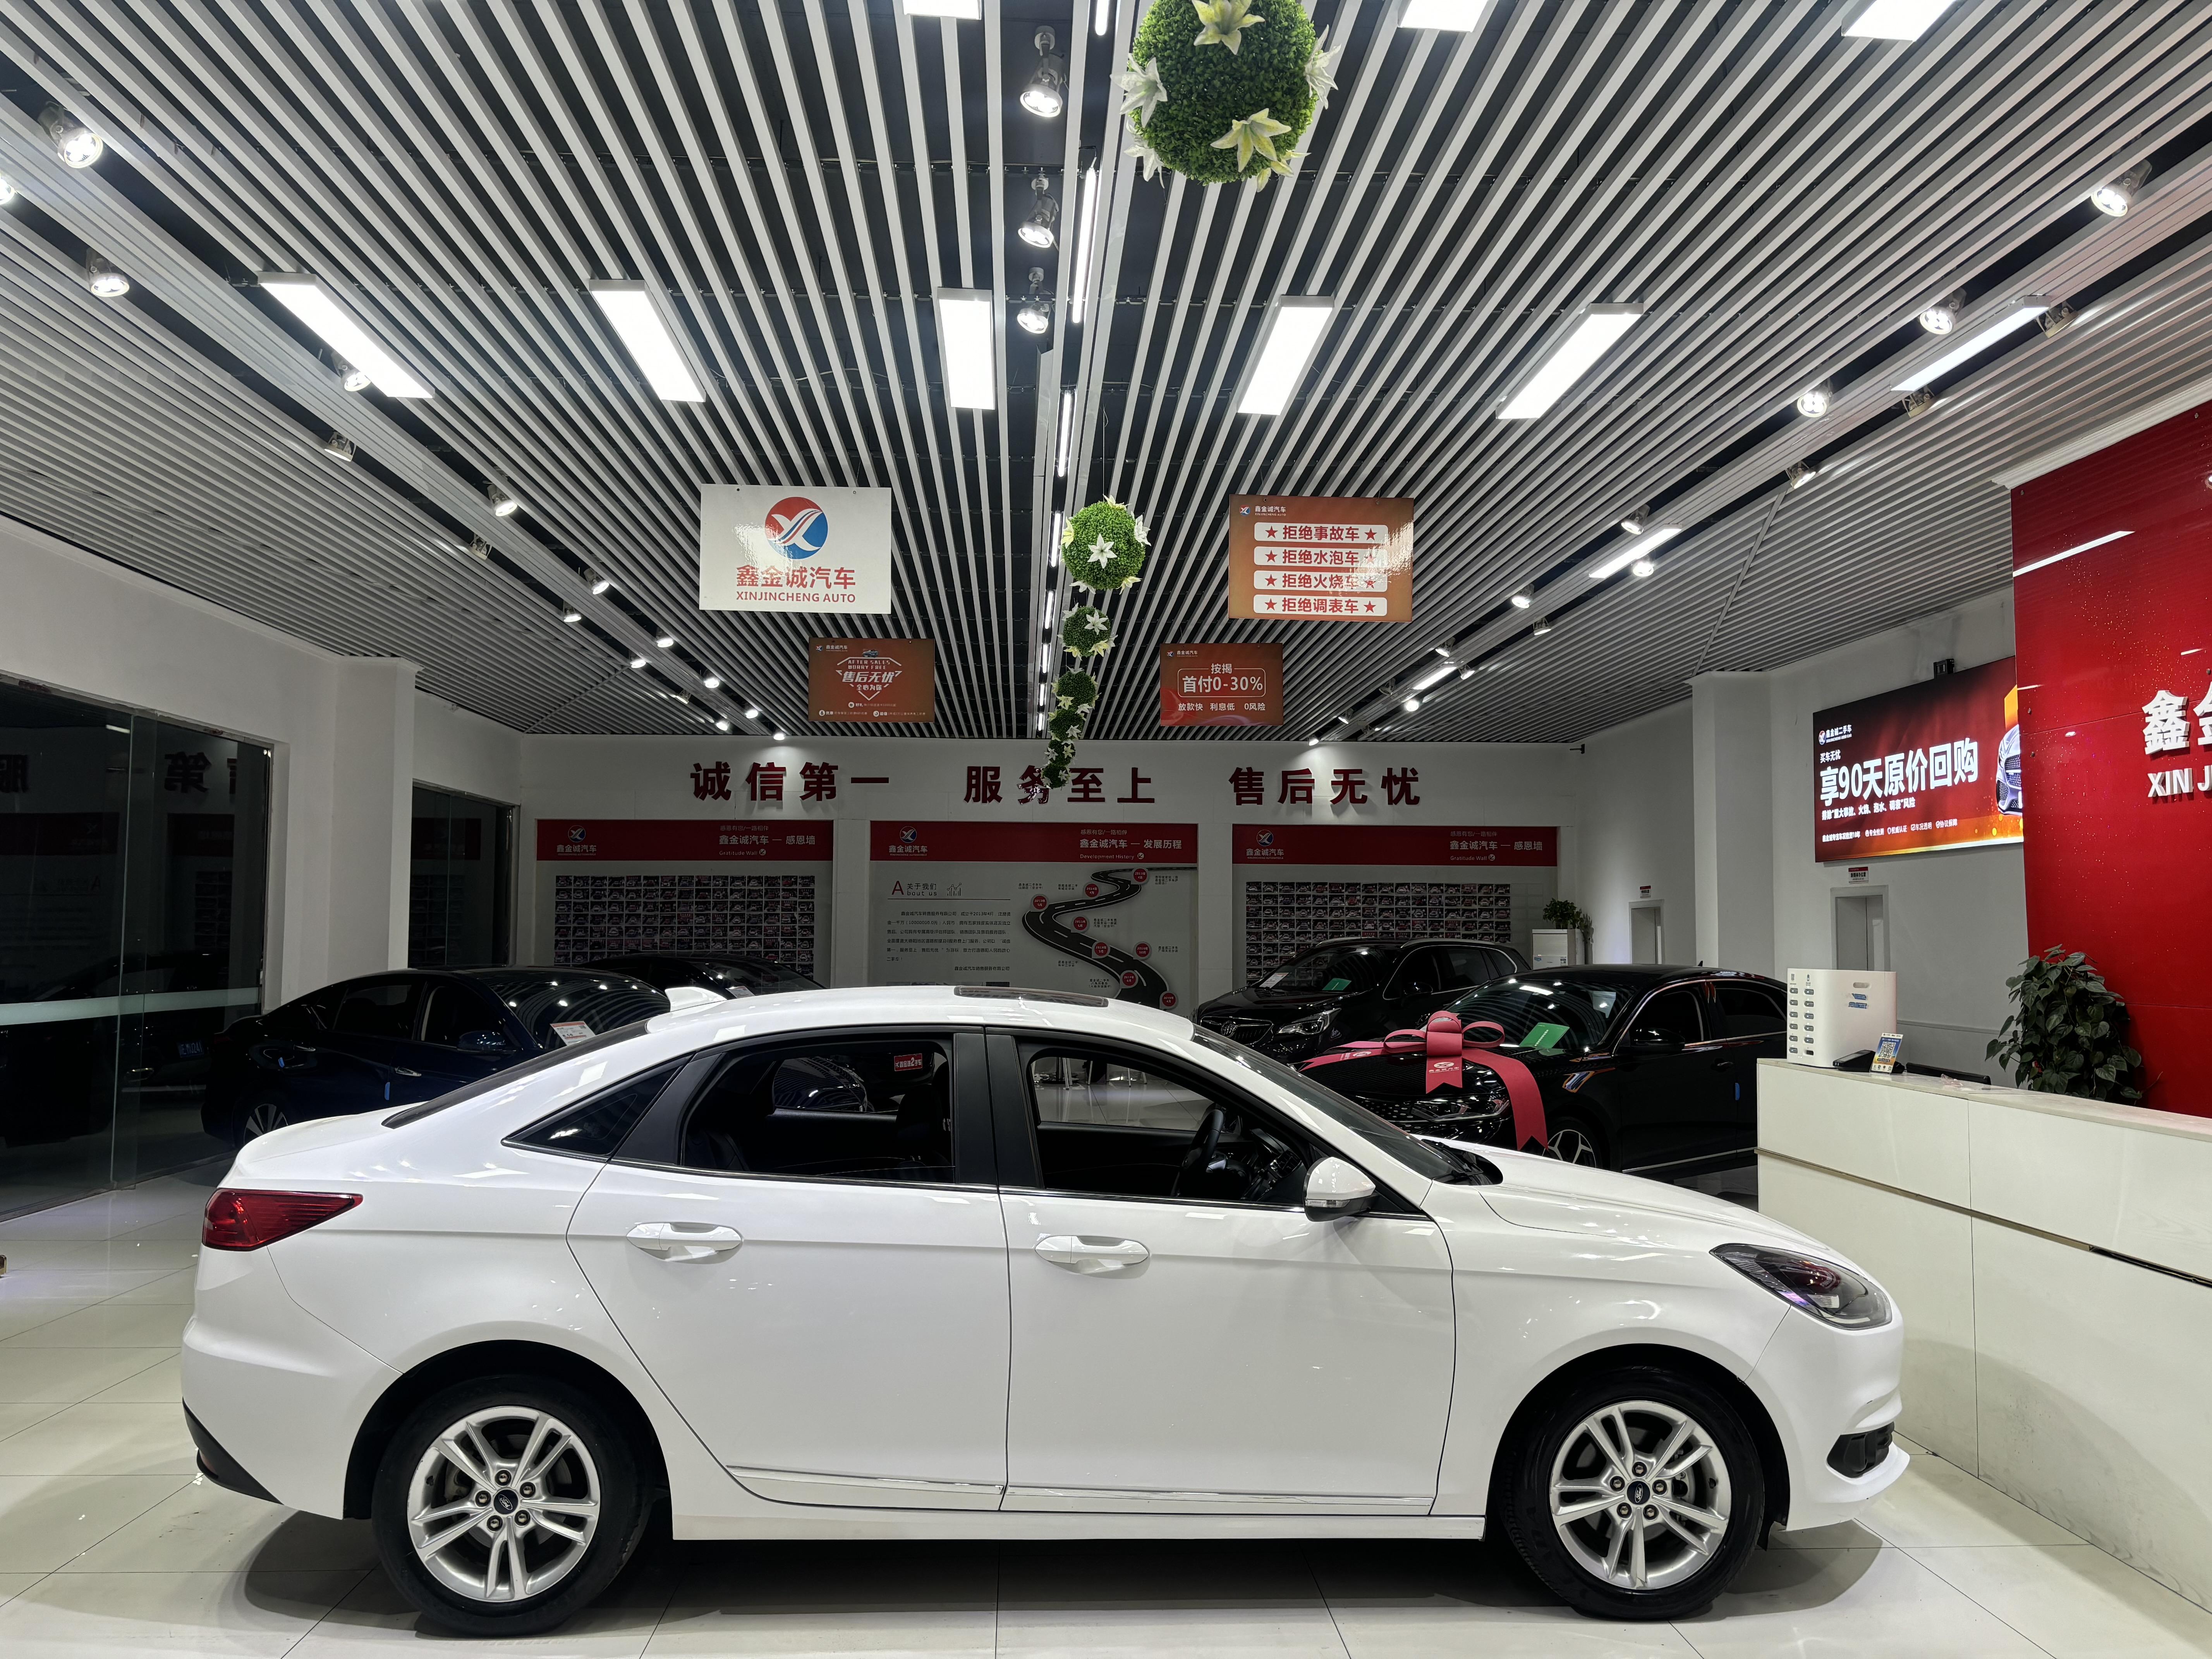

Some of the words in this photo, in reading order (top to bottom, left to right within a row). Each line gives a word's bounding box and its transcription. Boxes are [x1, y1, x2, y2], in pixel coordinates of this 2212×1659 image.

[1283, 525, 1359, 541] 拒绝事故车
[1282, 549, 1359, 565] 拒绝水泡车
[736, 565, 856, 589] 鑫金诚汽车
[1282, 573, 1358, 589] 拒绝火烧车
[736, 591, 820, 602] XINJINCHENG
[823, 593, 855, 603] AUTO
[1282, 597, 1358, 614] 拒绝调表车
[1211, 663, 1232, 674] 按揭
[842, 671, 895, 683] 售后无忧
[1182, 676, 1263, 692] 首付0-30%
[1178, 703, 1203, 711] 放款快
[1210, 703, 1235, 711] 利息低
[1244, 702, 1266, 711] 0风险
[1820, 749, 1841, 763] 买车无忧
[1820, 737, 1978, 807] 享90天原价回购
[690, 761, 889, 801] 诚信第一
[963, 765, 1155, 805] 服务至上
[1228, 767, 1420, 805] 售后无忧
[2147, 768, 2194, 797] XIN
[1891, 825, 1907, 834] 权威认证
[1915, 822, 1932, 831] 车况透明
[1940, 819, 1958, 828] 协议保障
[719, 835, 769, 845] 鑫金诚汽车
[786, 835, 815, 845] 感恩墙
[1080, 839, 1128, 848] 鑫金诚汽车
[1144, 839, 1182, 849] 发展历程
[1449, 840, 1498, 850] 鑫金诚汽车
[1514, 841, 1543, 850] 感恩墙
[556, 844, 597, 853] 鑫金诚汽车
[1246, 848, 1285, 856] 鑫金诚汽车
[892, 881, 904, 895] A
